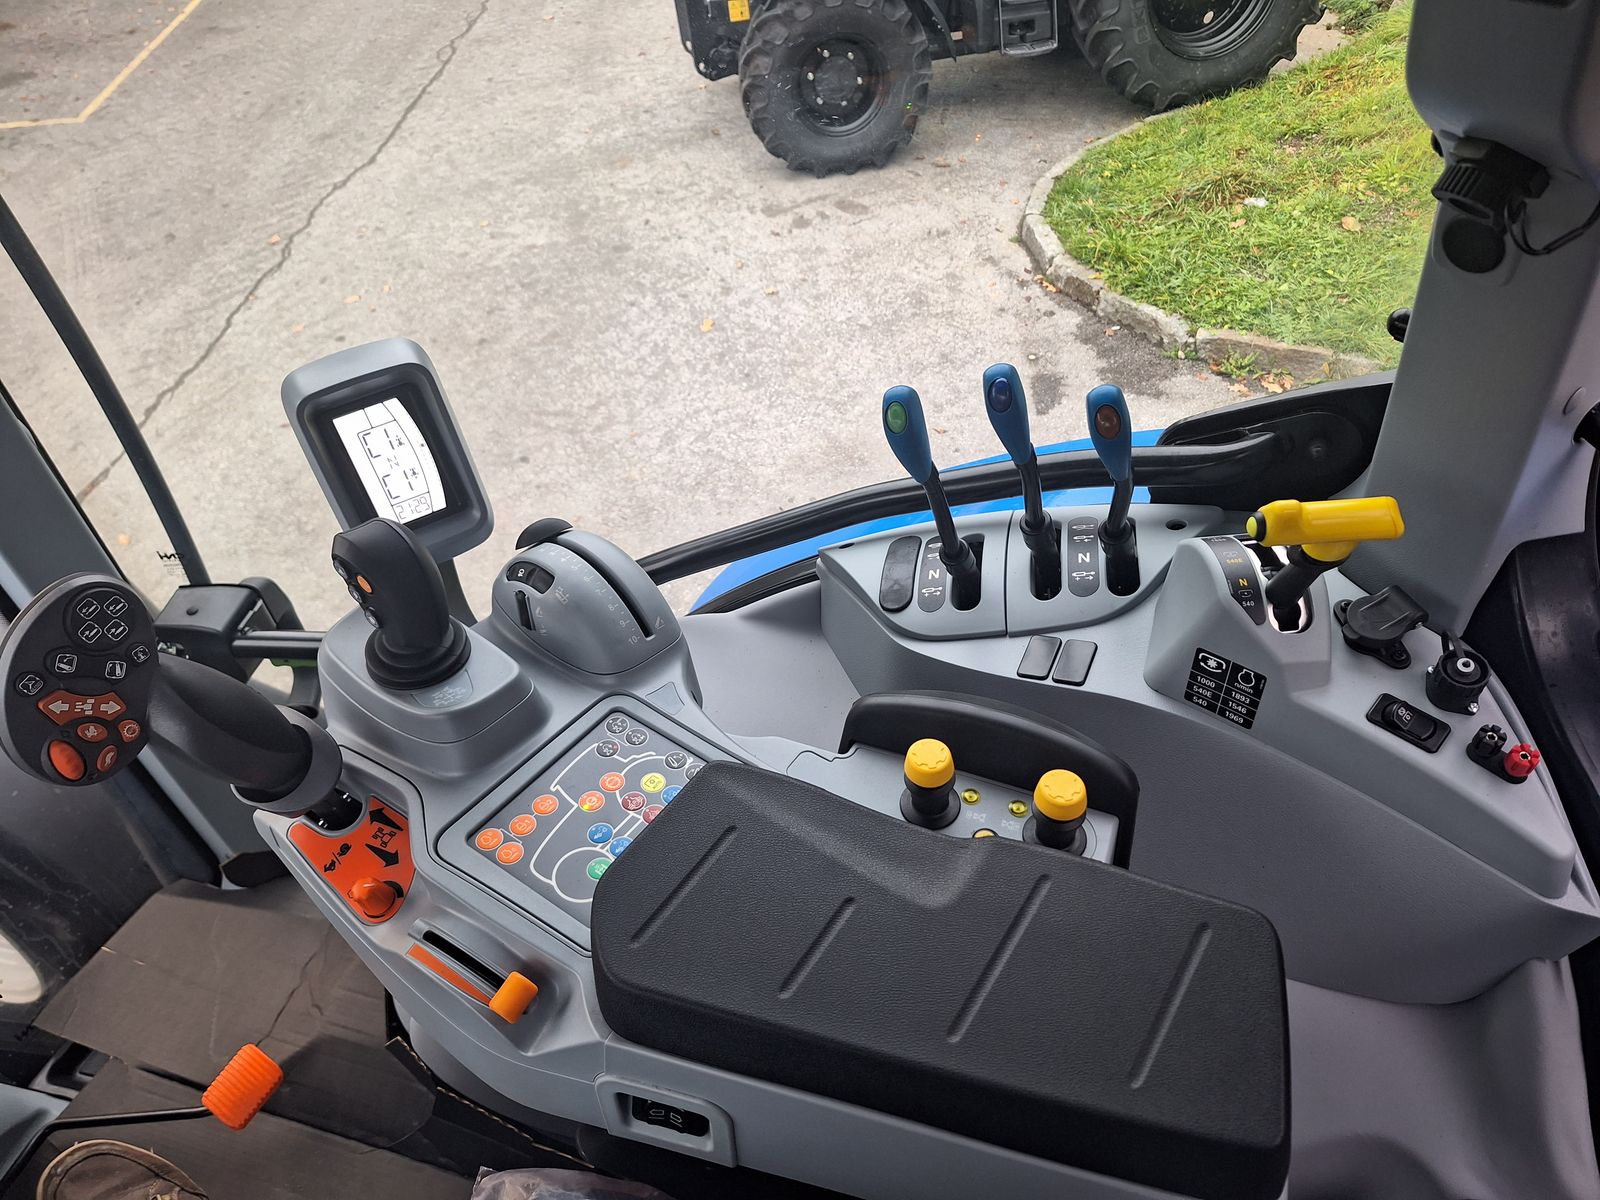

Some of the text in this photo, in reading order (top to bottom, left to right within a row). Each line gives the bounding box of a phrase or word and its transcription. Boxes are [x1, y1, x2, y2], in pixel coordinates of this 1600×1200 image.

[1077, 552, 1091, 564] N
[928, 568, 940, 580] N
[1238, 578, 1249, 587] N
[628, 635, 638, 646] 10
[1196, 675, 1251, 704] 1000 1893
[1234, 682, 1254, 694] n/min
[1192, 685, 1247, 714] 540E 1546
[1192, 696, 1244, 724] 540 1969
